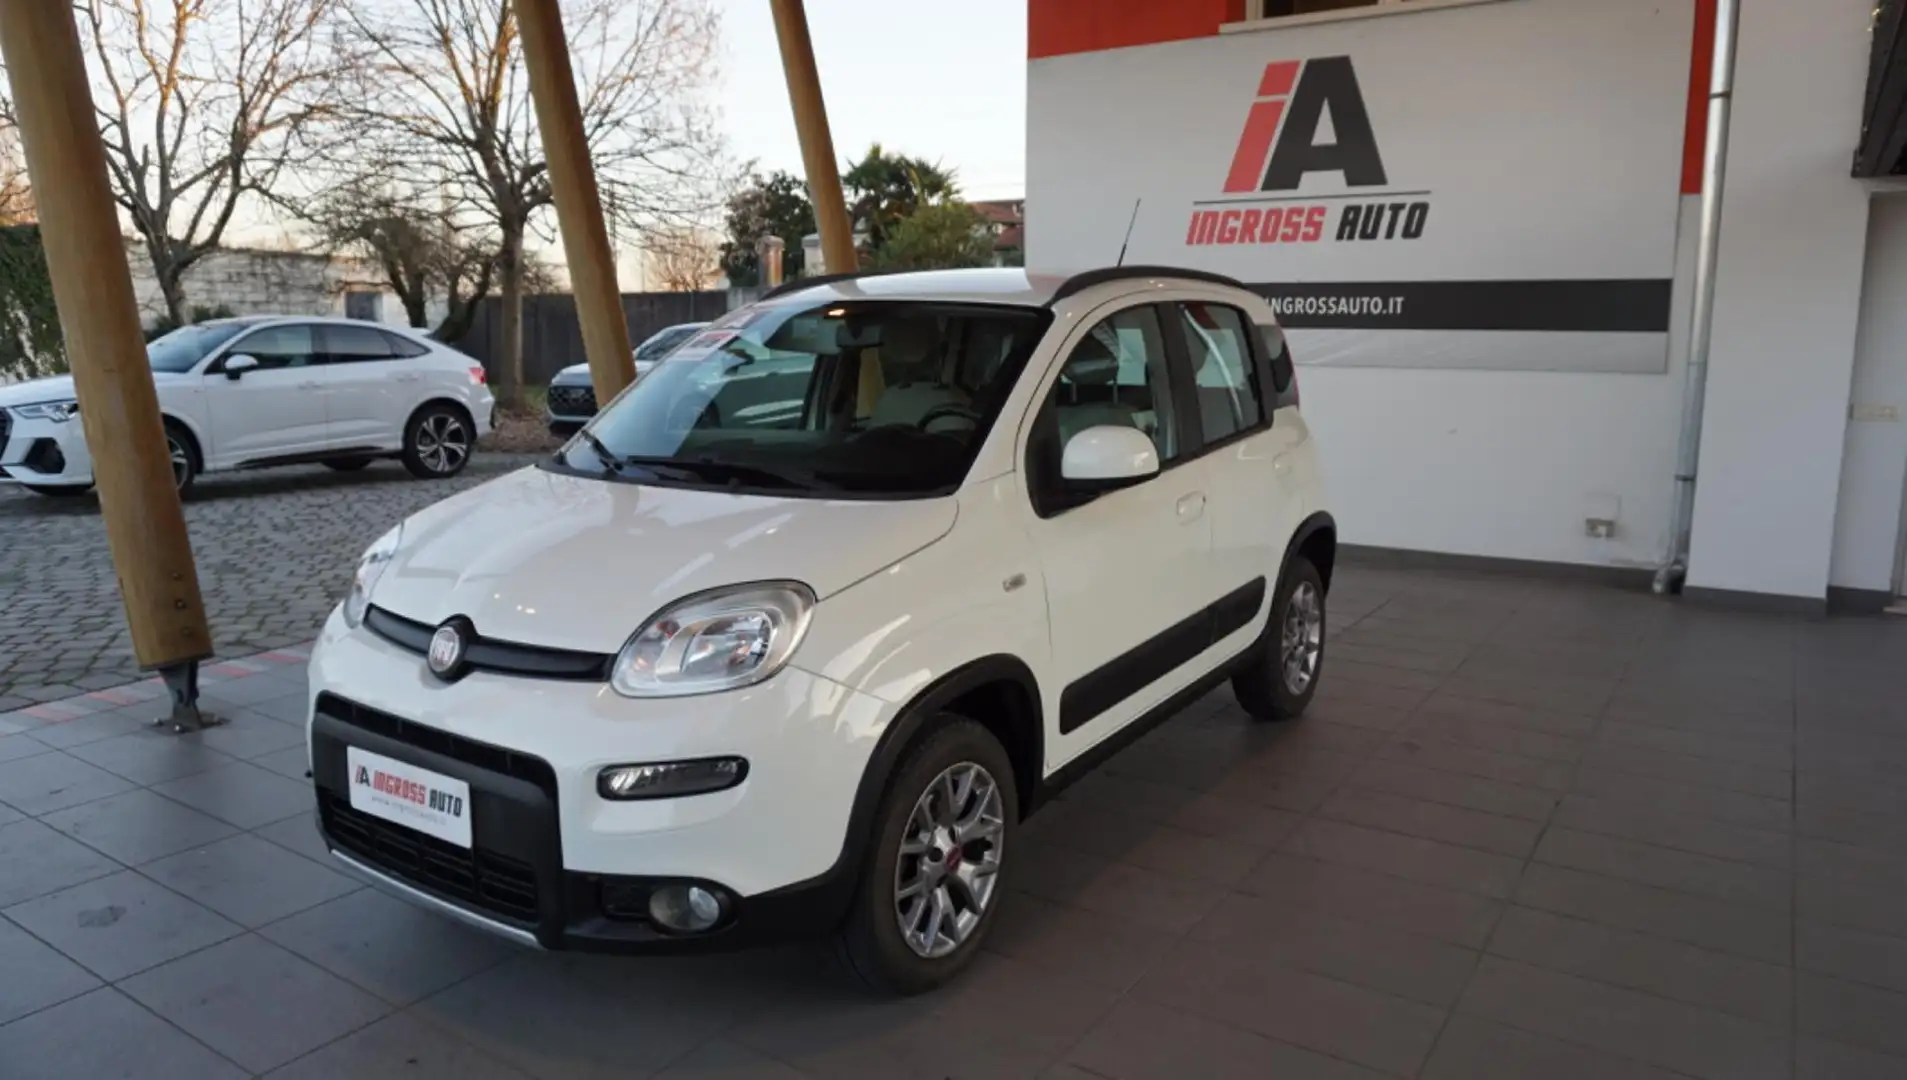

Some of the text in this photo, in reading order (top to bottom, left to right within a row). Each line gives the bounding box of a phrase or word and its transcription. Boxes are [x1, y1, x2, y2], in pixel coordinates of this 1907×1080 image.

[1185, 202, 1430, 246] INGROSS AUTO
[1265, 296, 1404, 315] NGROSSAUTO.IT
[373, 770, 427, 805] INGROSS
[429, 788, 463, 818] AUTO
